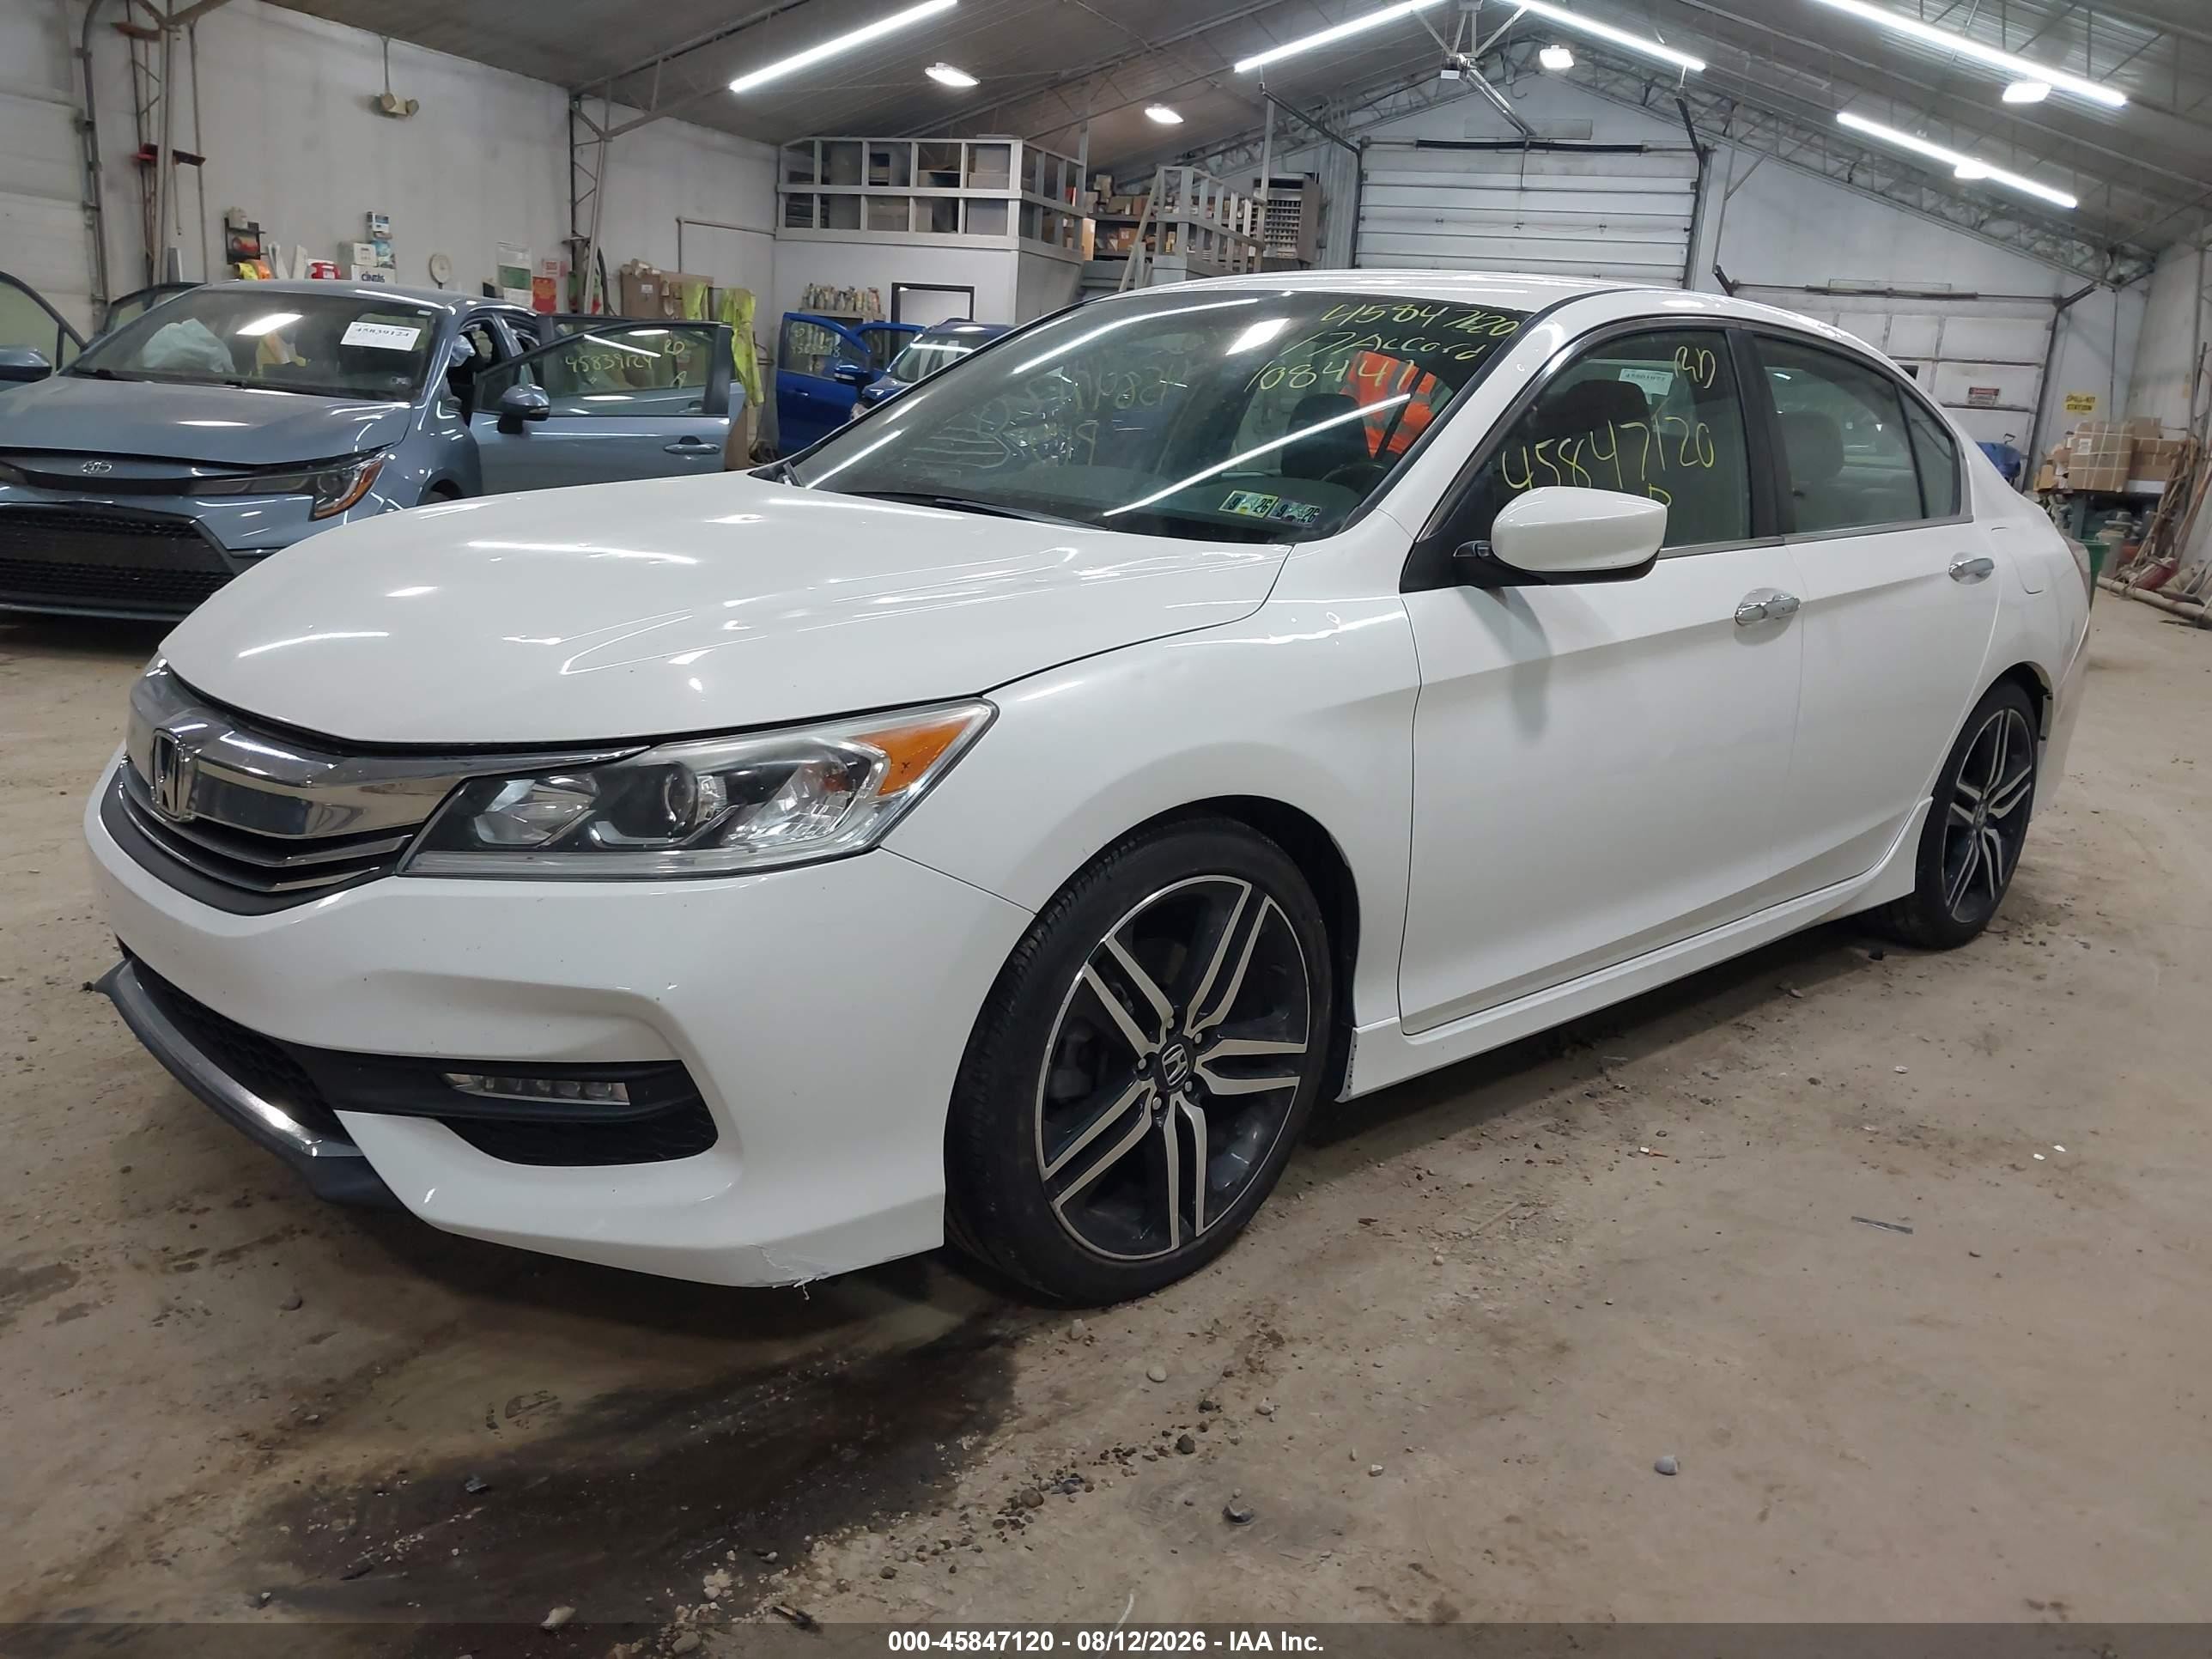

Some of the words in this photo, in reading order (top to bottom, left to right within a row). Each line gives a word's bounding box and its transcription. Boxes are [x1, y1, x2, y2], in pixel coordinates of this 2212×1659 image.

[565, 353, 654, 373] 45839124
[1502, 410, 1715, 489] 45847120
[1253, 498, 1273, 514] 26
